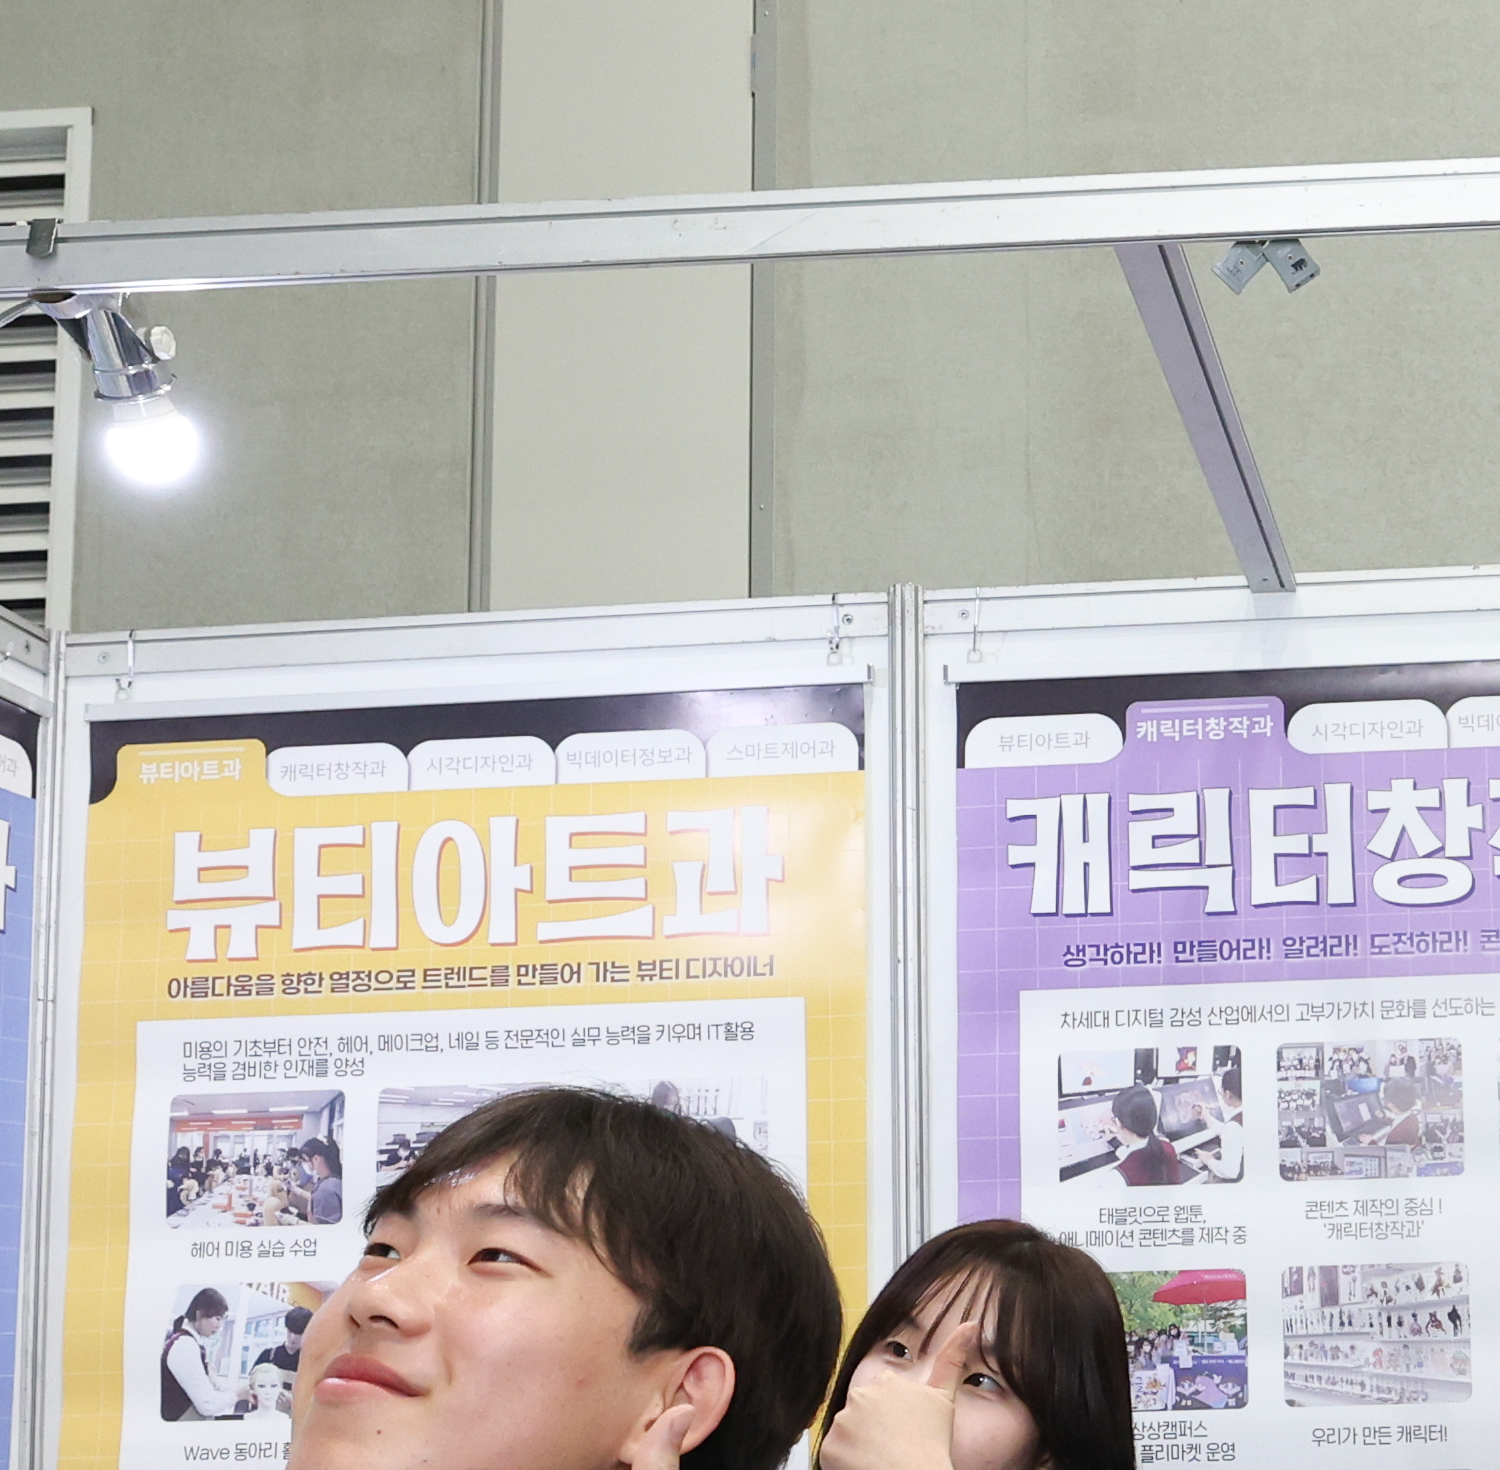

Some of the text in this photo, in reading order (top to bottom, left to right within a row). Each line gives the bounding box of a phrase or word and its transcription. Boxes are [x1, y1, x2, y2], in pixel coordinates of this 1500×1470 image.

[1135, 714, 1275, 743] 캐릭터창작과
[1311, 718, 1424, 741] 시각디자인과
[725, 738, 837, 763] 스마트제어과
[998, 730, 1091, 753] 뷰티아트과
[426, 753, 534, 777] 시각디자인과
[565, 745, 693, 770] 빅데이터정보과
[138, 758, 243, 785] 뷰티아트과
[279, 758, 387, 783] 캐릭터창작과
[166, 804, 786, 962] 뷰티아트과
[1062, 940, 1163, 968] 생각하라!
[1173, 937, 1272, 964] 만들어라!
[1282, 933, 1359, 960] 알려라!
[1369, 929, 1469, 957] 도전하라!
[167, 954, 775, 999] 아름다움을 향한 열정으로 트렌드를 만들어 가는 뷰티 디자이너
[1060, 1010, 1111, 1030] 차세대
[1115, 1008, 1165, 1028] 디지털
[1206, 1003, 1291, 1026] 산업에서의
[1295, 1000, 1376, 1023] 고부가가치
[1379, 998, 1428, 1020] 문화를
[1431, 995, 1497, 1018] 선도하는
[183, 1028, 566, 1060] 미용의 기초부터 전문적인
[182, 1056, 366, 1083] 능력을 겸비한 인재를 양성
[1098, 1204, 1171, 1226] 태블릿으로
[1304, 1199, 1350, 1220] 콘텐츠
[1138, 1227, 1196, 1248] 콘텐츠를
[190, 1241, 221, 1260] 헤어
[1311, 1426, 1359, 1446] 우리가
[184, 1445, 230, 1462] Wave
[234, 1440, 279, 1462] 동아리
[1139, 1443, 1202, 1464] 플리마켓
